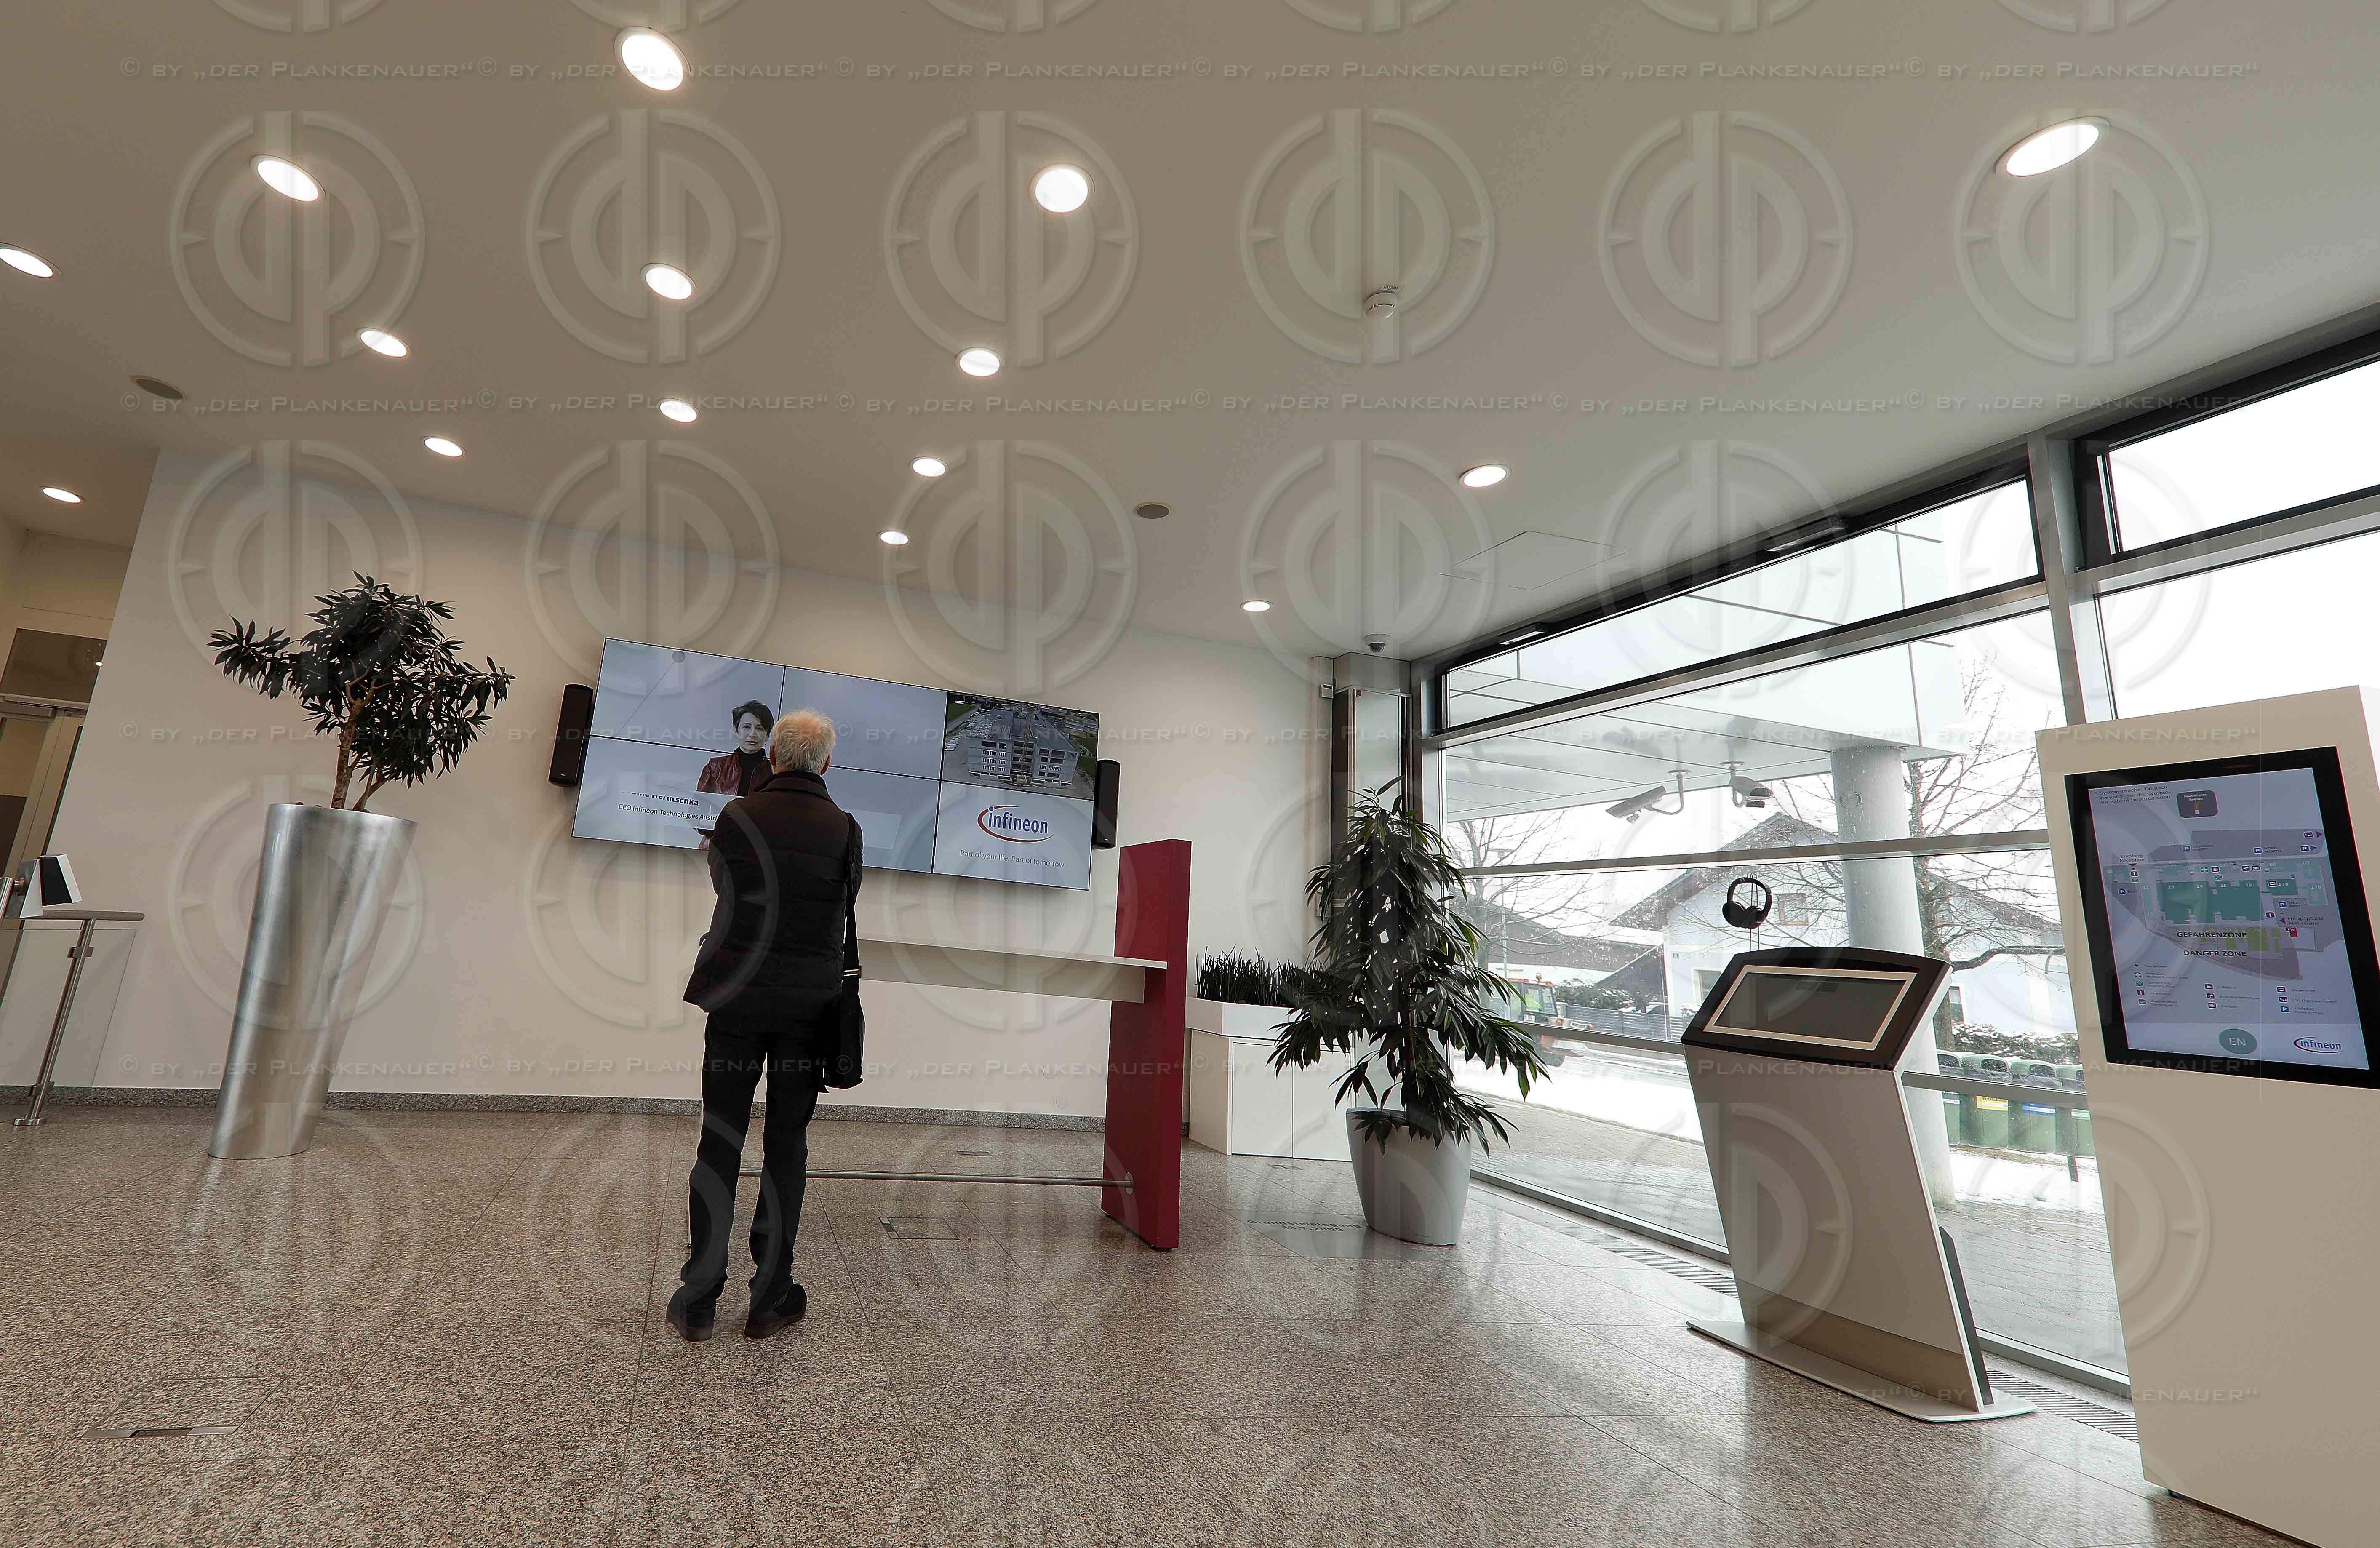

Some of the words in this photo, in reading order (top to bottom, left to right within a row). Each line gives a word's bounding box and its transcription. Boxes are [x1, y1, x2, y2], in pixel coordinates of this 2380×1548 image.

[632, 806, 658, 815] Infineon
[659, 809, 699, 819] Technologies
[960, 849, 974, 858] Part
[1033, 858, 1066, 868] tomorrow.
[2229, 1038, 2247, 1046] EN
